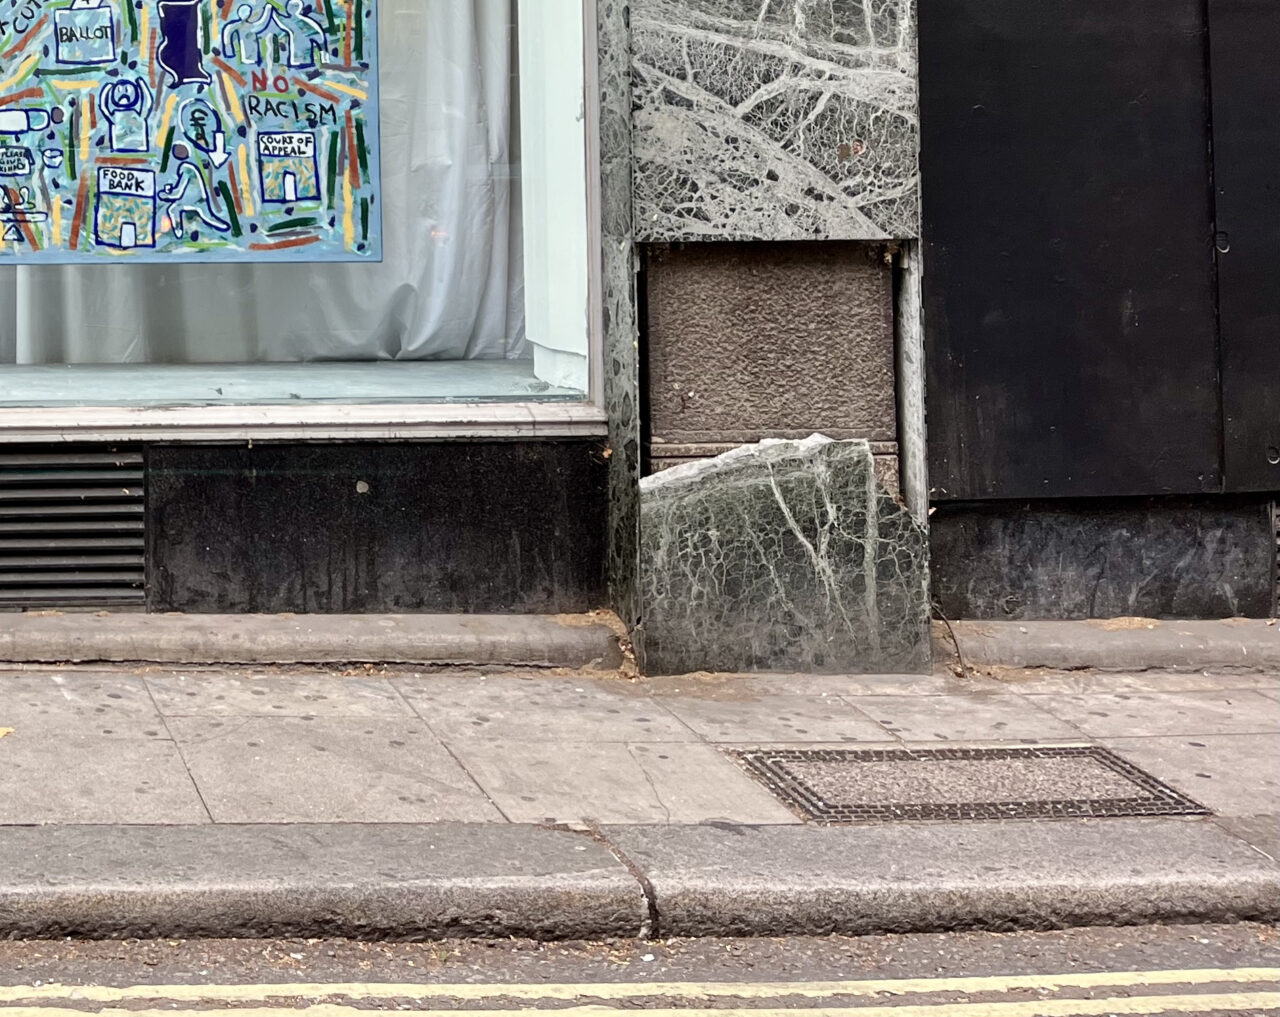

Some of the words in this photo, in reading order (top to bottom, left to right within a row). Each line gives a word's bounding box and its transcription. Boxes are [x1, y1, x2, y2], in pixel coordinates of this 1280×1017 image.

[59, 25, 111, 44] BALLOT
[251, 67, 290, 94] NO
[247, 94, 338, 126] RACISM
[260, 135, 294, 146] COURT
[297, 136, 313, 148] OF
[262, 145, 307, 156] APPEAL
[102, 169, 135, 182] FOOD
[108, 176, 145, 192] BANK
